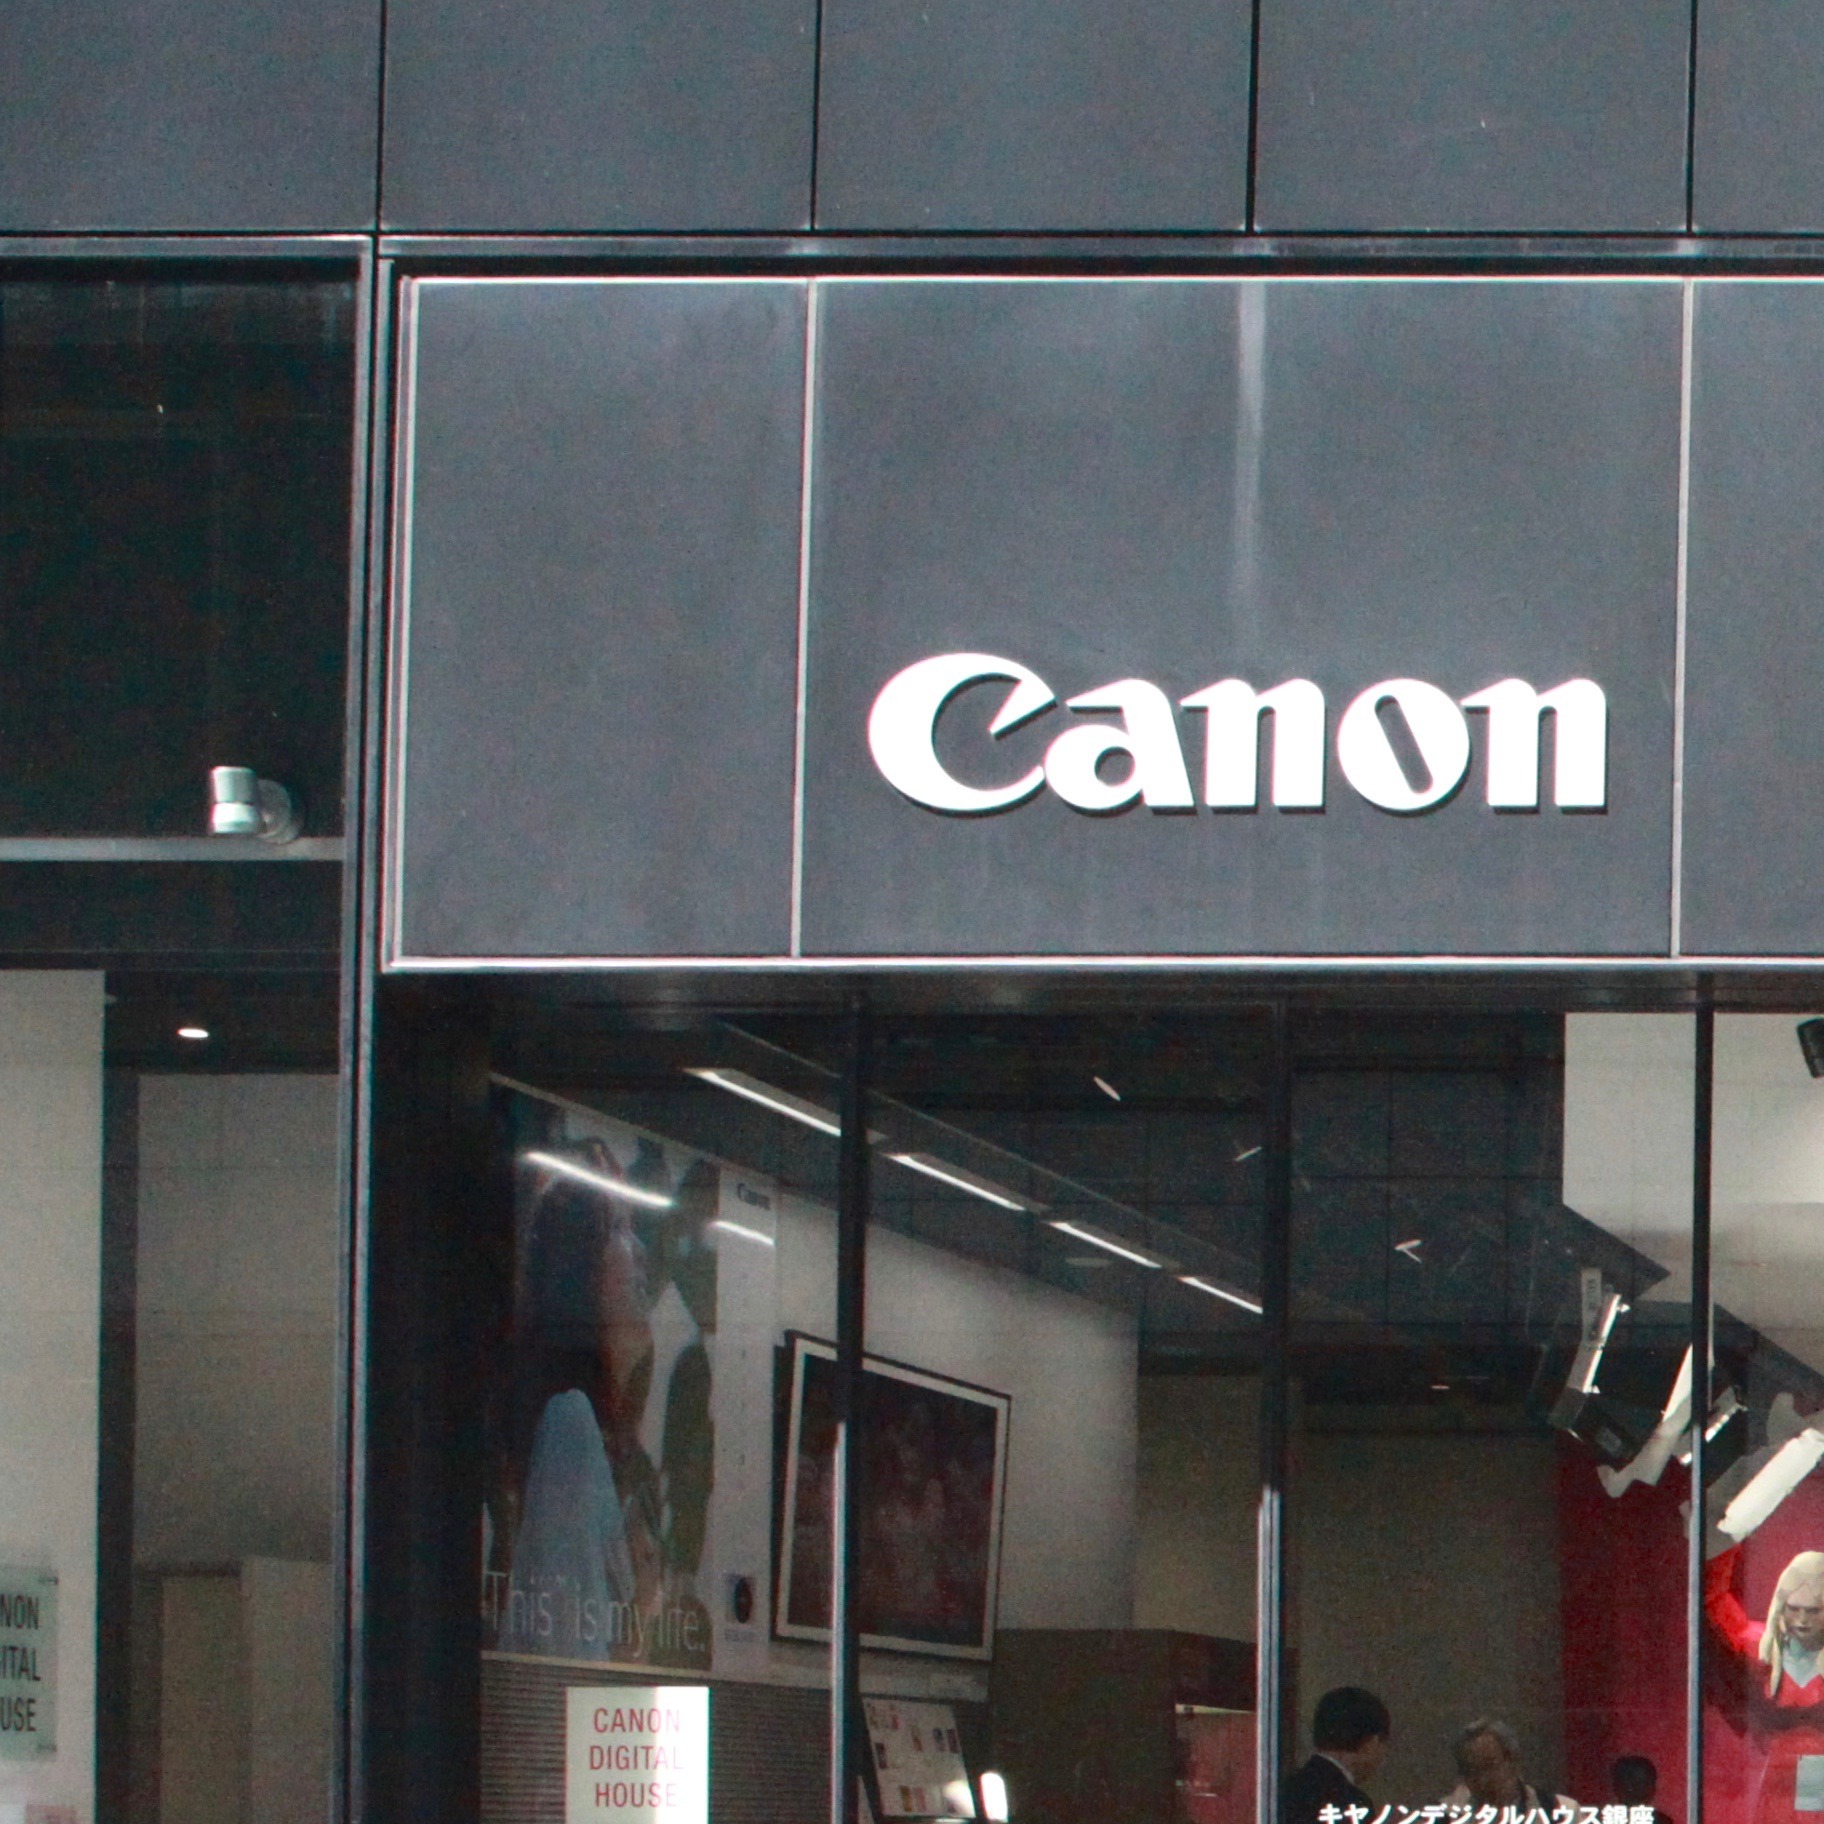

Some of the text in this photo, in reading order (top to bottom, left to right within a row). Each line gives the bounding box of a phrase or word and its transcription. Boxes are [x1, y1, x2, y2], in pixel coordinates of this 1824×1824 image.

[868, 652, 1607, 811] Canon
[0, 1594, 39, 1629] NON
[485, 1570, 552, 1637] This
[574, 1582, 598, 1643] is
[609, 1600, 645, 1658] my
[0, 1697, 36, 1731] USE
[594, 1708, 680, 1733] CANON
[589, 1745, 684, 1770] DIGITAL
[595, 1782, 677, 1807] HOUSE
